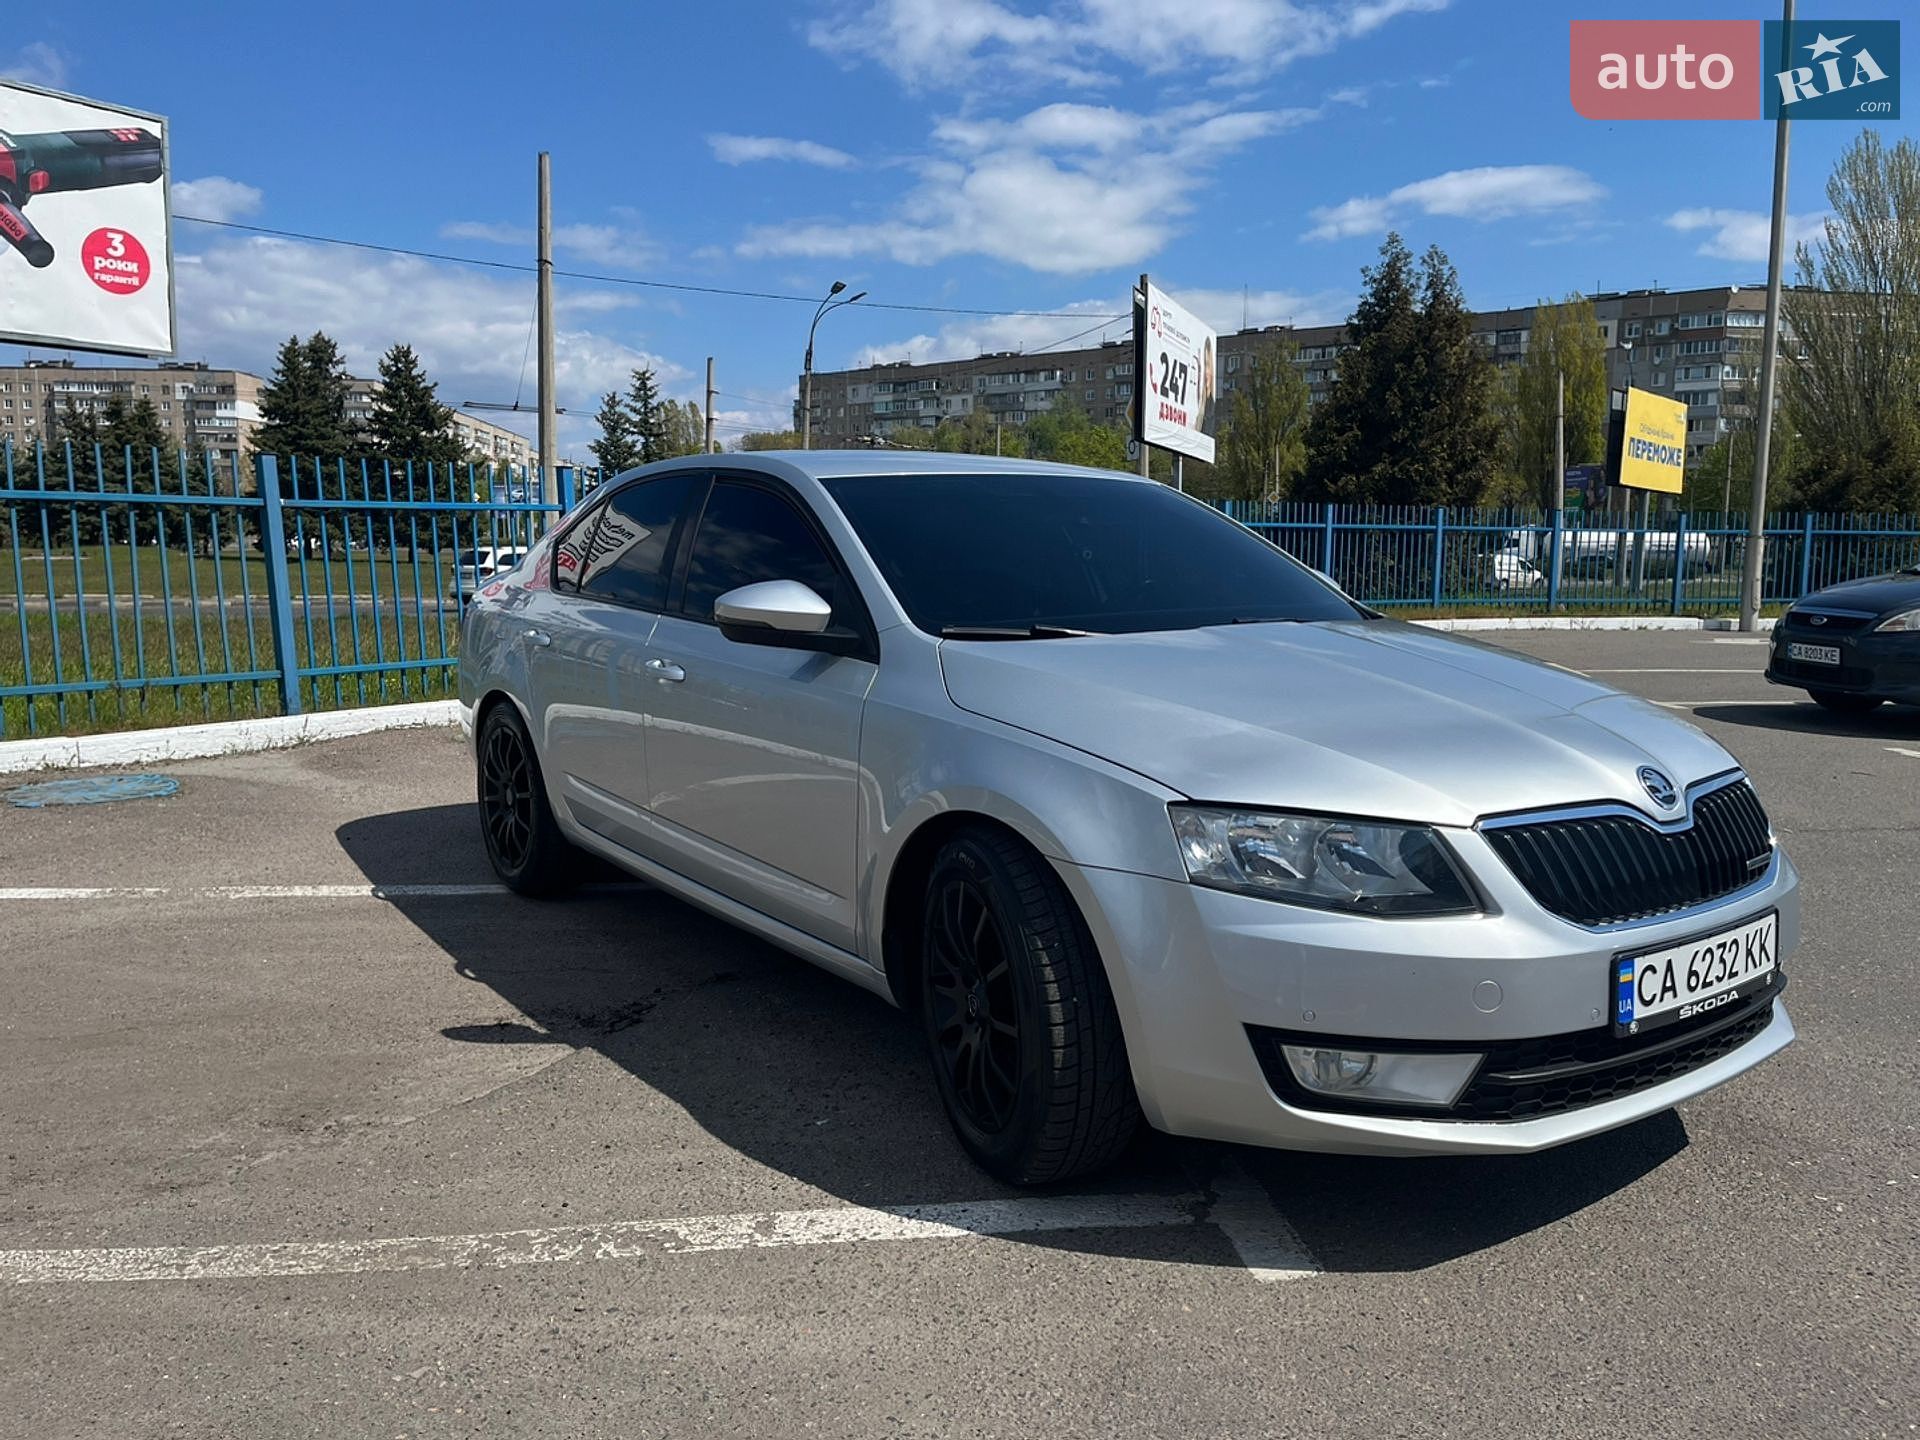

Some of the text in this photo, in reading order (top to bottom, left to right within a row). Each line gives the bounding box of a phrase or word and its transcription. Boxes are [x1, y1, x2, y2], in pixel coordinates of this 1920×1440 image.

[105, 231, 126, 257] 3
[93, 255, 139, 274] роки
[1160, 351, 1187, 405] 247
[1159, 402, 1187, 427] ДЗВОНИ
[1628, 437, 1682, 467] ПЕРЕМОЖЕ
[1638, 922, 1772, 1007] CA 6232 KK
[1618, 998, 1632, 1014] UA
